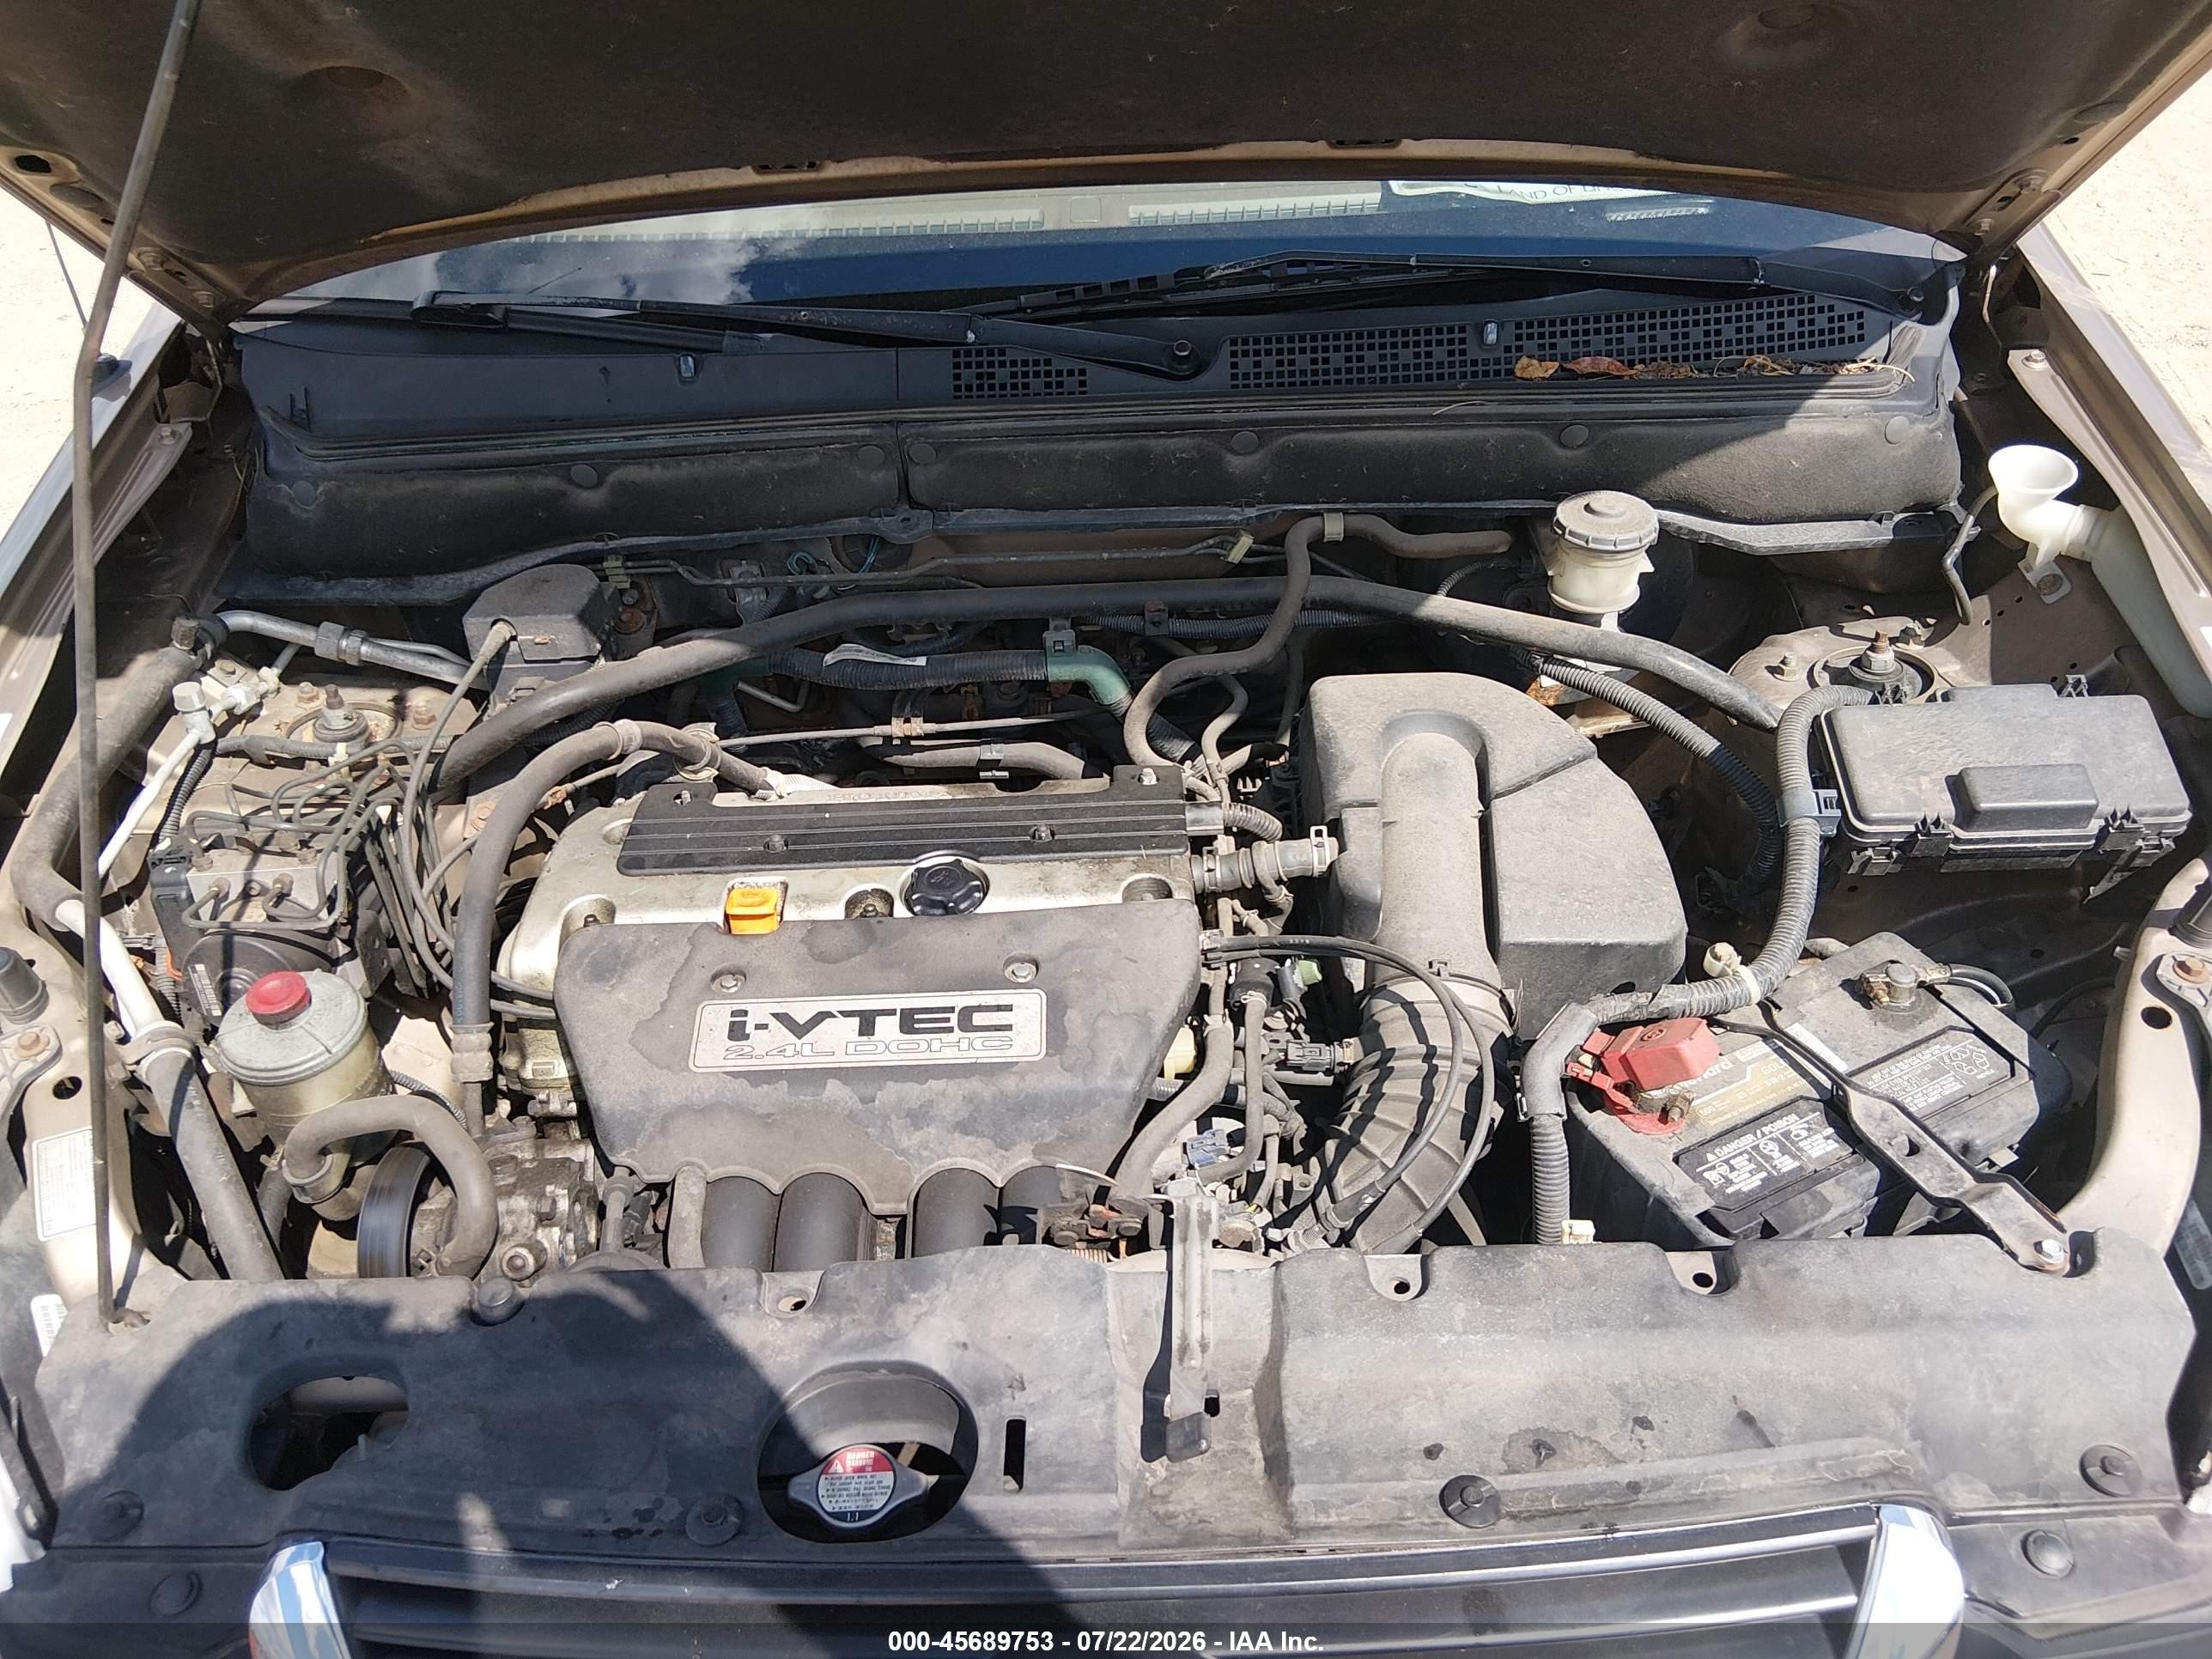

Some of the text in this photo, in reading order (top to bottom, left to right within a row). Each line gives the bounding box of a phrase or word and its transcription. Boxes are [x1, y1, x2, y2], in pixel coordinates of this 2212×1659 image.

[728, 1004, 1013, 1041] i-VTEC
[723, 1036, 1013, 1060] 2.4L DOHC
[1714, 1133, 1757, 1157] DANGER
[1761, 1113, 1800, 1134] POISON
[847, 1511, 859, 1522] 1.1
